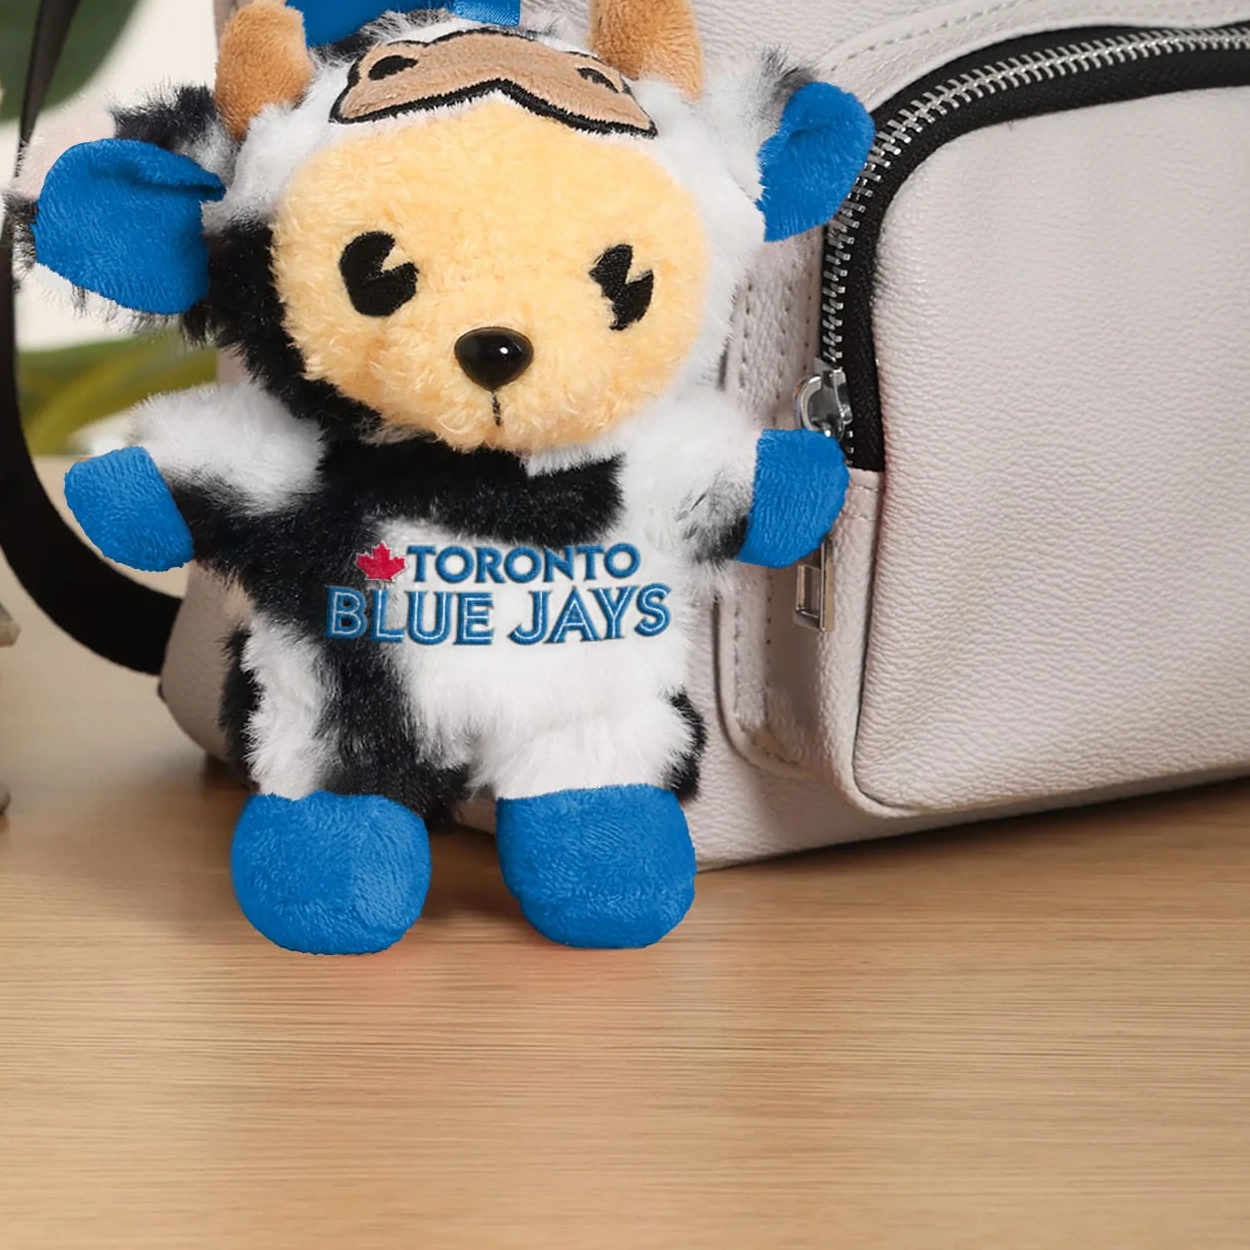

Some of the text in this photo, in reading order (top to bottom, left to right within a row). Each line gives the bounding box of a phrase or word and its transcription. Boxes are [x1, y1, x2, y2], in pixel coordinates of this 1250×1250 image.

[406, 542, 641, 583] TORONTO
[325, 582, 672, 645] BLUE JAYS
